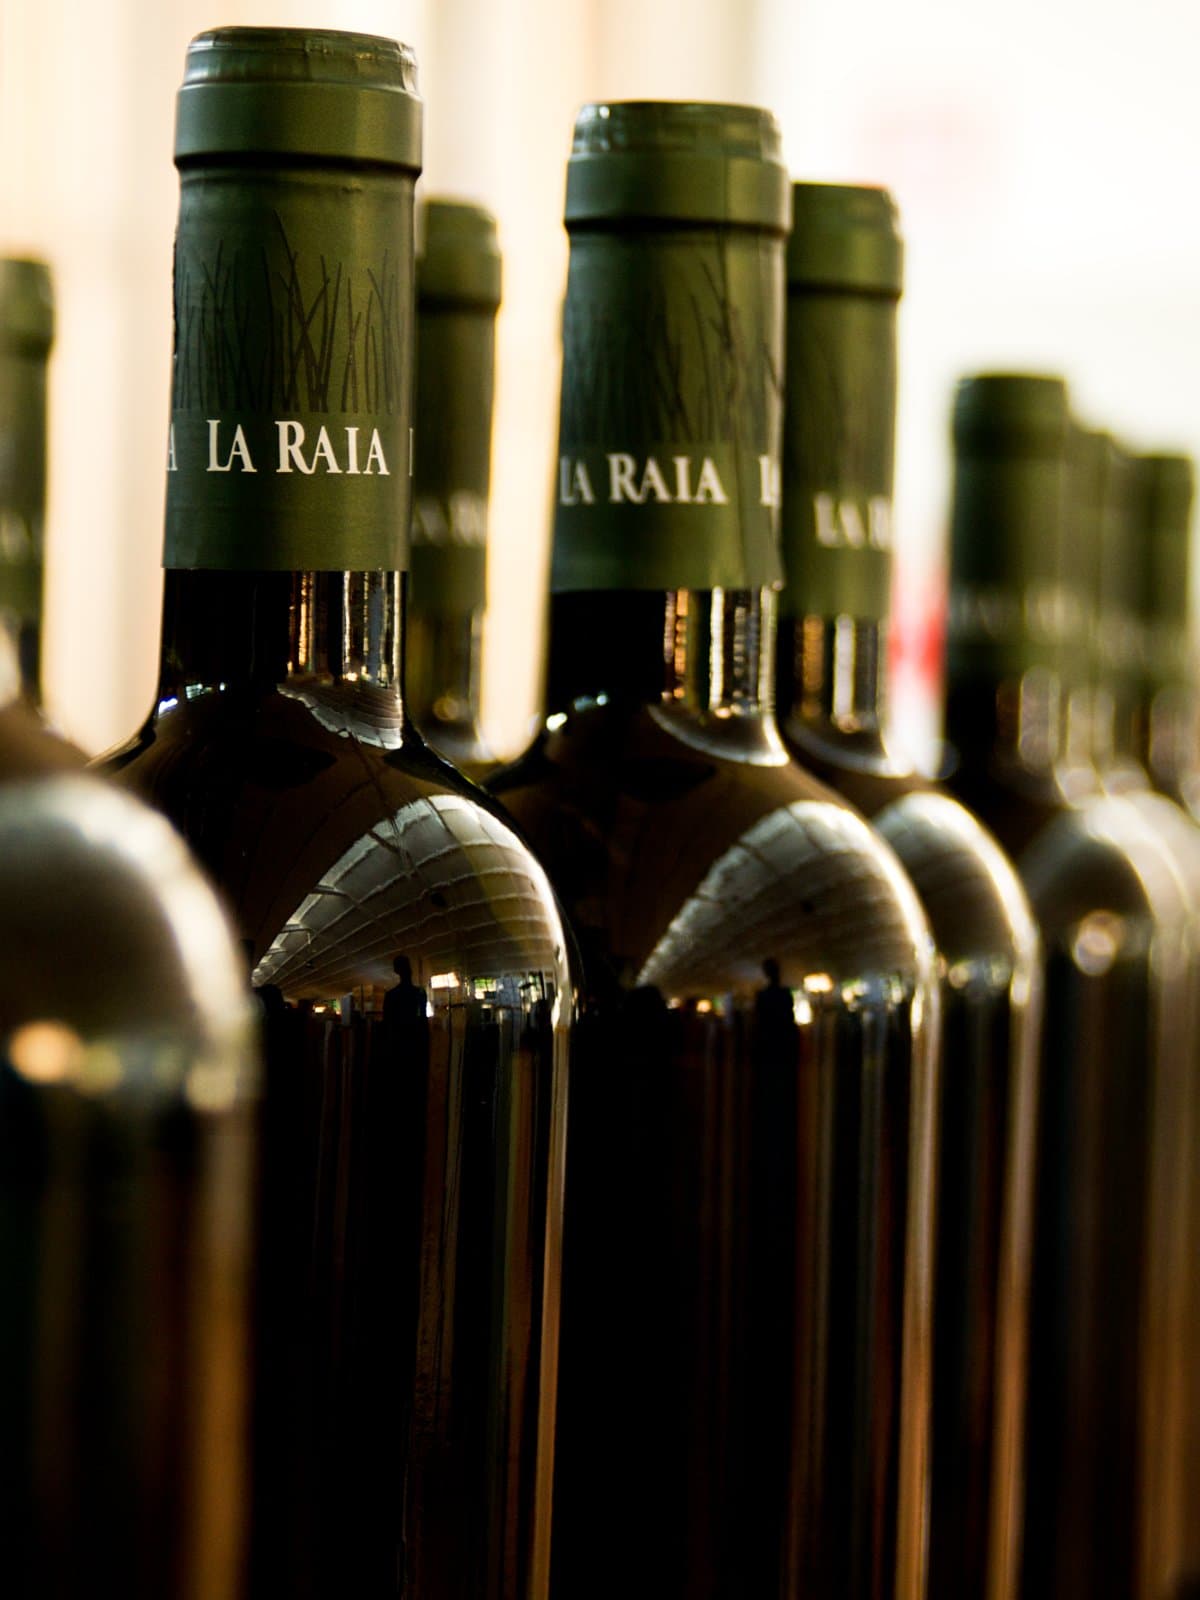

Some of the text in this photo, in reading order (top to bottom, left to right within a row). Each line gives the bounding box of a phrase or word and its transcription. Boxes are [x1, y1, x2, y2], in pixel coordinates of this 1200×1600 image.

[206, 419, 258, 473] LA
[275, 420, 391, 475] RAIA
[606, 453, 728, 504] RAIA
